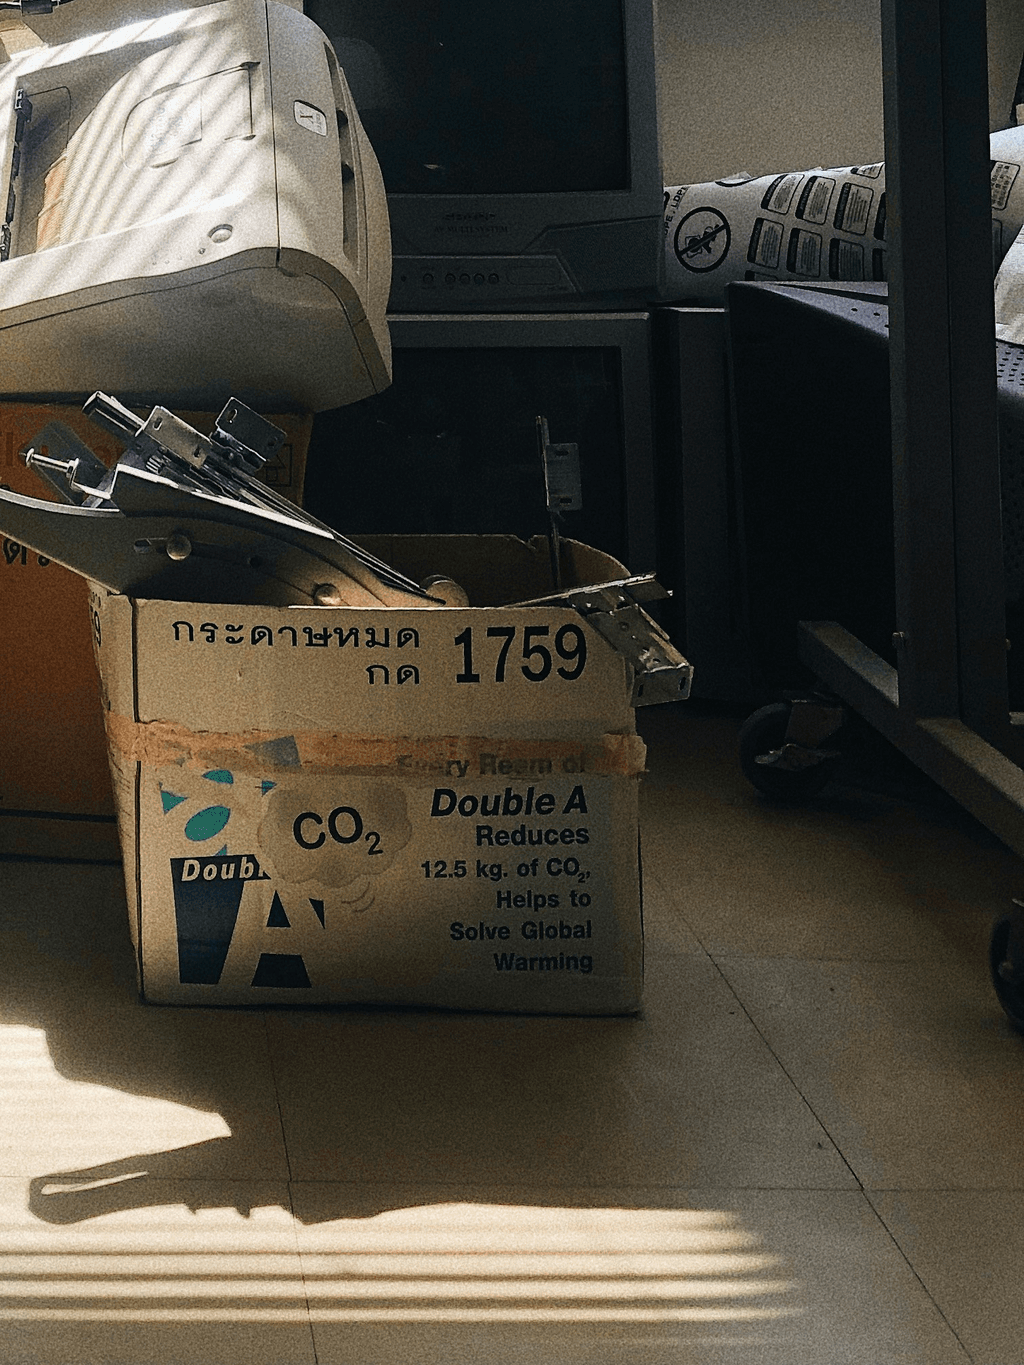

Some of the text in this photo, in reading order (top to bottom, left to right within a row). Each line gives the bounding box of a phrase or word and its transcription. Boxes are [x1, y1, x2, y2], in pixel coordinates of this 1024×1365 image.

[171, 620, 421, 649] กระดาษหมด
[454, 624, 588, 683] 1759
[365, 663, 421, 686] กด
[430, 785, 588, 817] Double A
[476, 824, 590, 847] Reduces
[421, 860, 467, 879] 12.5
[476, 859, 509, 882] kg.
[517, 858, 539, 877] of
[496, 889, 592, 912] Helps to
[449, 919, 593, 941] Solve Global
[493, 951, 594, 974] Warming
